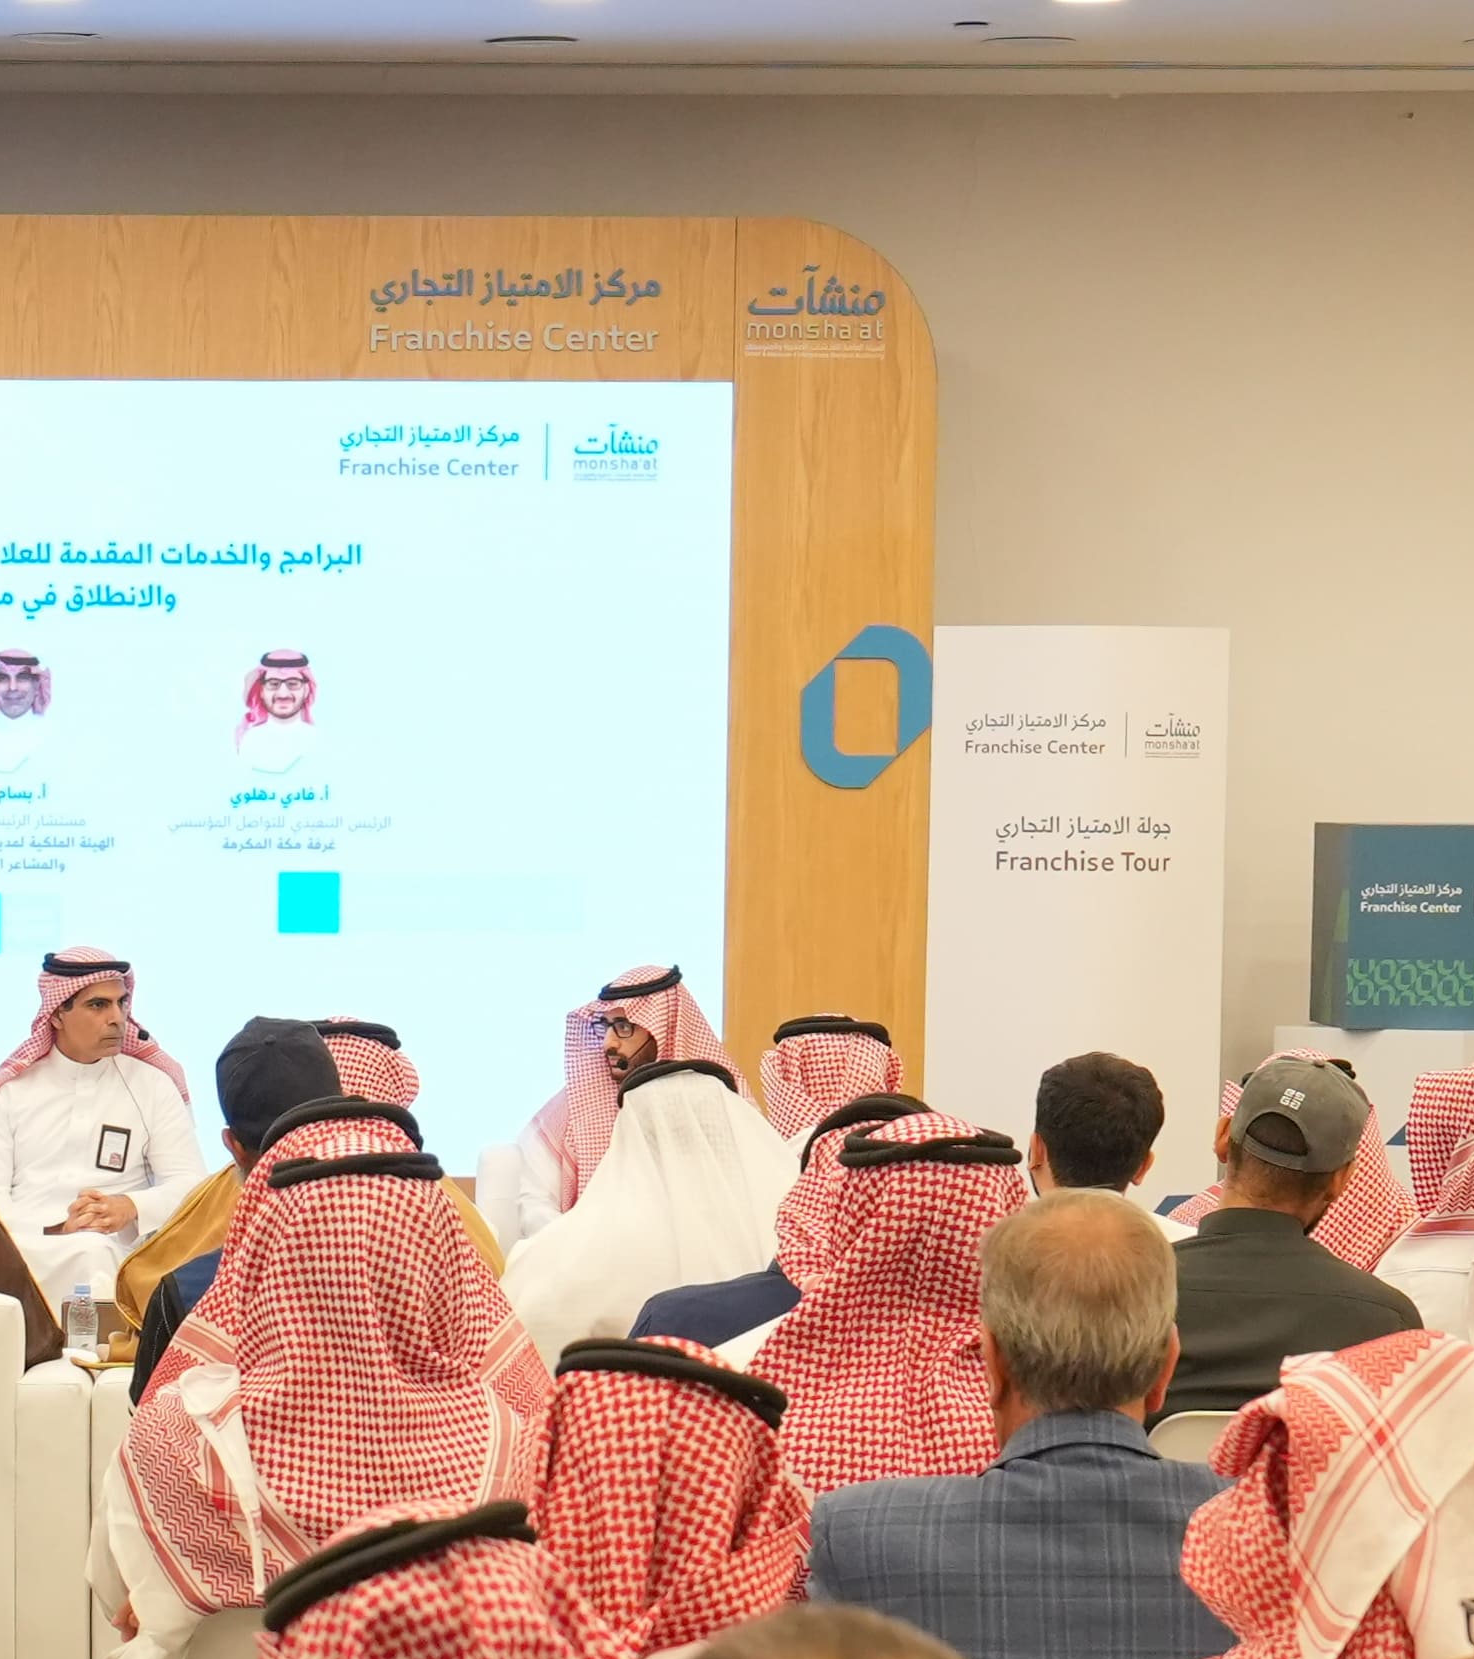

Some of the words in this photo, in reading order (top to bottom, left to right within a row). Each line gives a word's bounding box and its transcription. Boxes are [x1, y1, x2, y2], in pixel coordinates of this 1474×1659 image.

[370, 269, 473, 312] التجاري
[480, 269, 582, 307] الامتياز
[589, 269, 661, 307] مركز
[748, 265, 886, 316] منشآت
[370, 321, 532, 351] Franchise
[543, 323, 659, 351] Center
[339, 425, 403, 451] التجاري
[408, 426, 471, 447] الامتياز
[476, 426, 519, 446] مركز
[574, 423, 658, 454] منشآت
[339, 457, 439, 476] Franchise
[447, 459, 519, 476] Center
[60, 542, 153, 564] المقدمة
[161, 543, 271, 572] والخدمات
[280, 543, 362, 574] البرامج
[23, 584, 57, 620] في
[66, 584, 176, 612] والانطلاق
[966, 713, 1014, 735] التجاري
[1018, 713, 1067, 732] الامتياز
[1071, 713, 1106, 732] مركز
[1145, 713, 1201, 738] منشآت
[965, 740, 1042, 754] Franchise
[1047, 740, 1106, 755] Center
[229, 787, 276, 809] دهلوي
[995, 816, 1060, 843] التجاري
[1066, 816, 1130, 839] الامتياز
[1136, 816, 1171, 840] جولة
[29, 836, 75, 852] الملكية
[222, 837, 272, 852] المكرمة
[277, 837, 302, 850] مكة
[306, 838, 336, 853] غرفة
[8, 857, 66, 872] والمشاعر
[996, 850, 1114, 871] Franchise
[1121, 851, 1171, 872] Tour
[1360, 883, 1398, 898] التجاري
[1399, 884, 1435, 897] الامتياز
[1436, 884, 1463, 897] مركز
[1360, 901, 1418, 913] Franchise
[1419, 902, 1462, 913] Center
